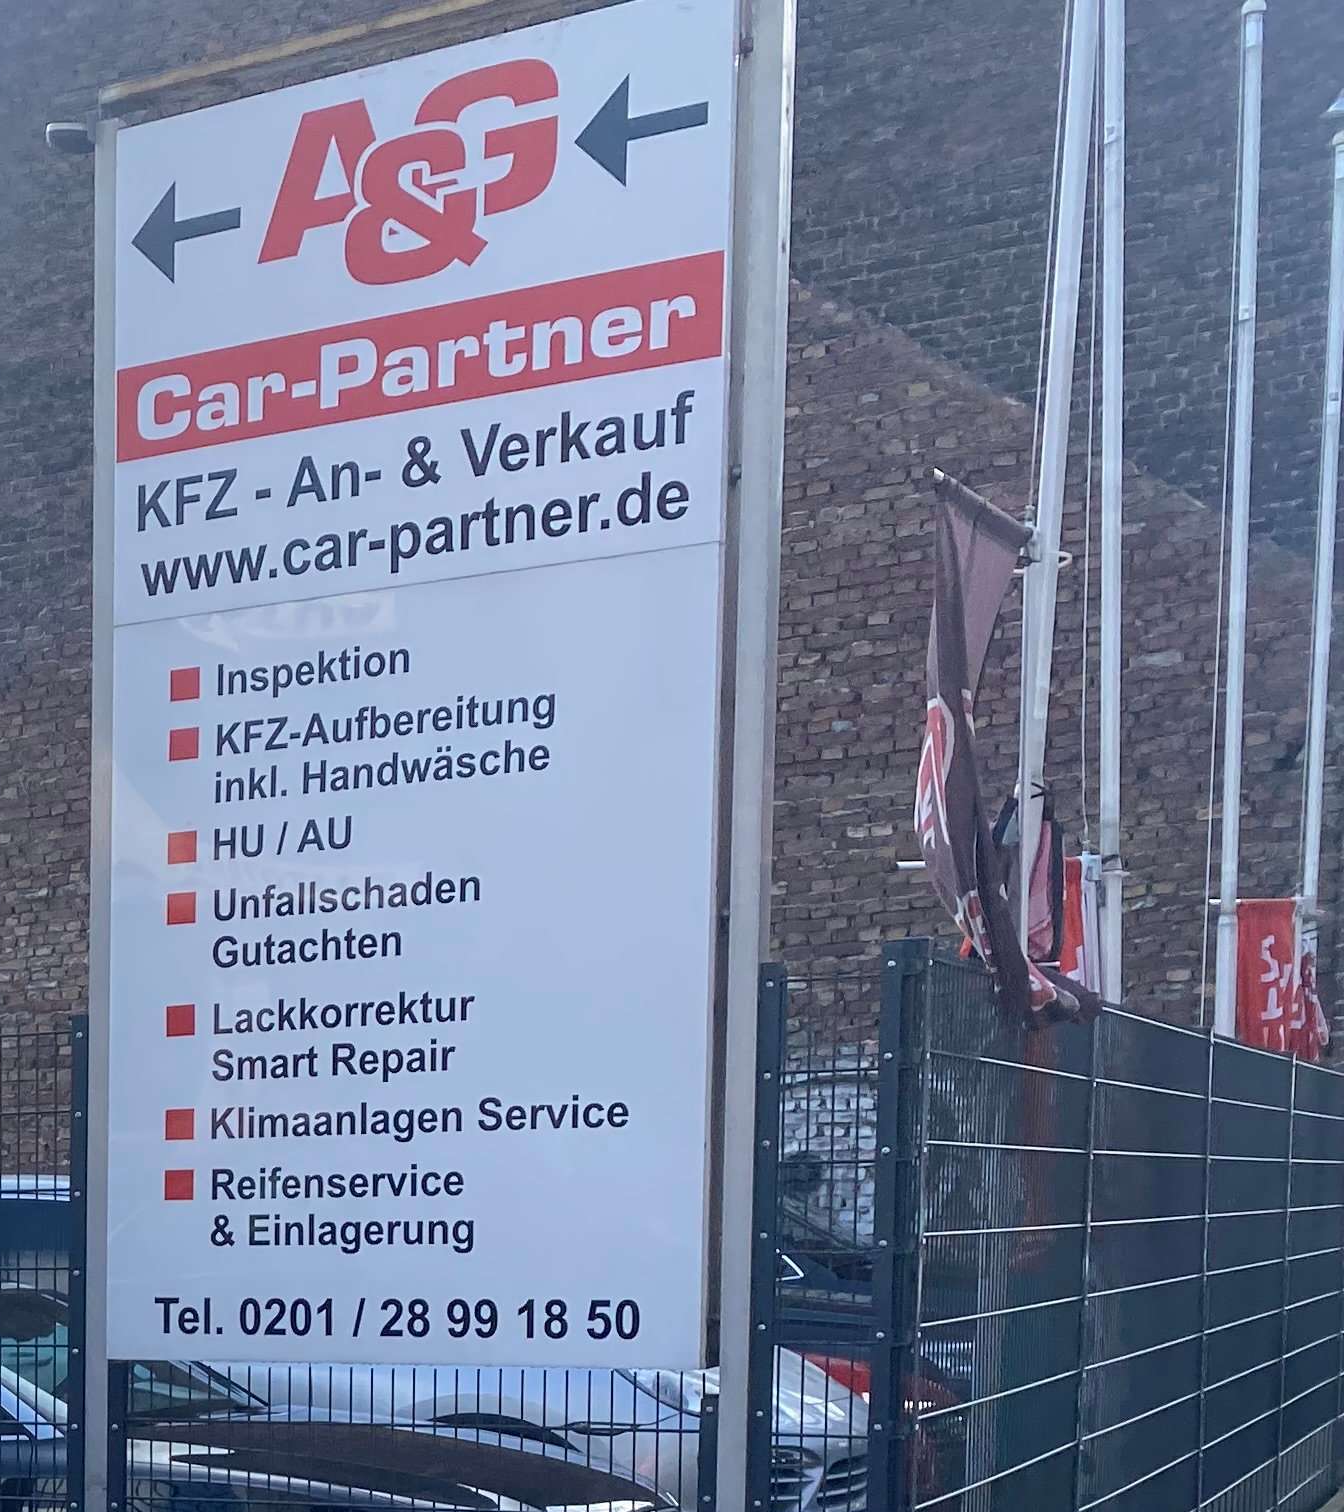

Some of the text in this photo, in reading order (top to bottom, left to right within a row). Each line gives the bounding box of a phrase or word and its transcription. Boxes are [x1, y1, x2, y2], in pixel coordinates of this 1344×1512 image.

[257, 57, 559, 286] A&G
[135, 293, 697, 441] Car-Partner
[137, 469, 238, 533] KFZ
[287, 456, 382, 508] An-
[401, 436, 442, 488] &
[461, 390, 696, 478] Verkauf
[140, 472, 690, 597] www.car-partner.de
[216, 645, 410, 699] Inspektion
[216, 691, 556, 757] KFZ-Aufbereitung
[214, 740, 550, 804] inkl. Handwäsche
[213, 815, 352, 861] HU / AU
[213, 871, 481, 922] Unfallschaden
[212, 927, 402, 969] Gutachten
[213, 991, 476, 1035] Lackkorrektur
[211, 1038, 457, 1083] Smart Repair
[210, 1095, 630, 1143] Klimaanlagen Service
[211, 1163, 465, 1201] Reifenservice
[210, 1213, 475, 1255] & Einlagerung
[154, 1296, 640, 1340] Tel. 0201 / 28 99 18 50
